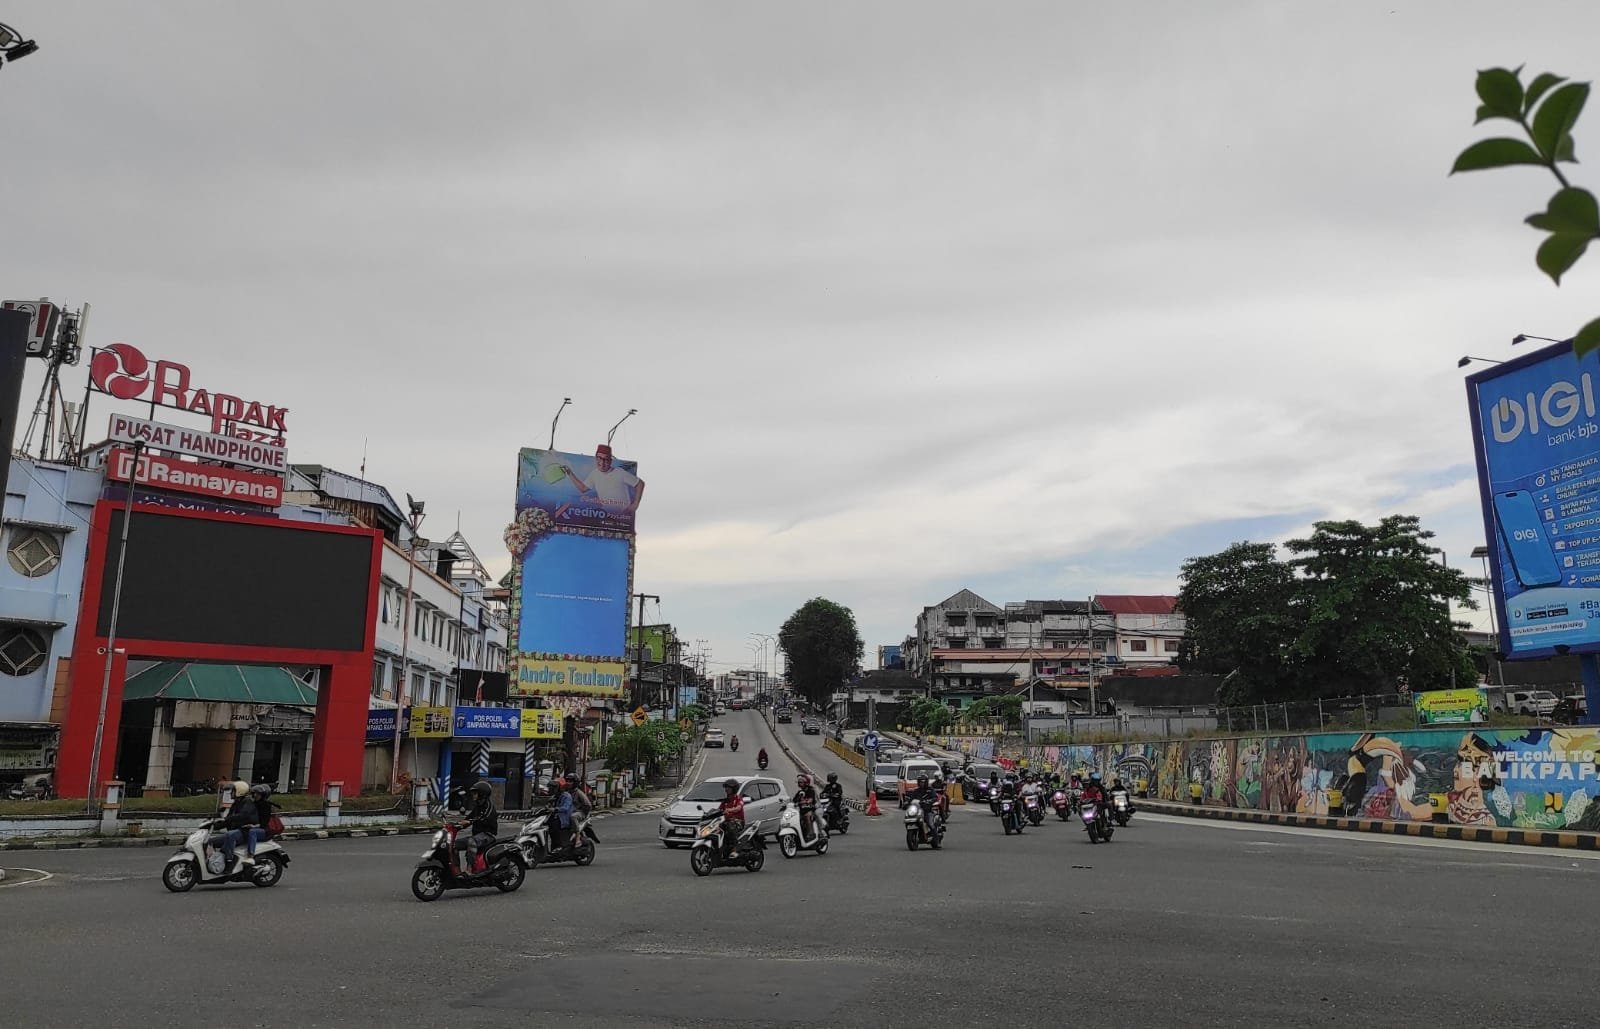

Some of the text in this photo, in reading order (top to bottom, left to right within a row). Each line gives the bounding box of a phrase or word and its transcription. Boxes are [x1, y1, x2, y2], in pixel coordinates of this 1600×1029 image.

[1490, 372, 1596, 443] DIGI
[1547, 422, 1599, 446] bank bjb
[115, 418, 284, 467] PUSAT HANDPHONE
[151, 462, 278, 500] Ramayana
[1576, 551, 1600, 561] TRANSF
[1577, 558, 1600, 568] TERJAD
[1580, 600, 1600, 611] #Ba
[1589, 610, 1600, 619] Ja
[519, 664, 623, 690] Andre Taulany
[474, 714, 485, 722] POS
[1492, 749, 1595, 762] WELCOME TO
